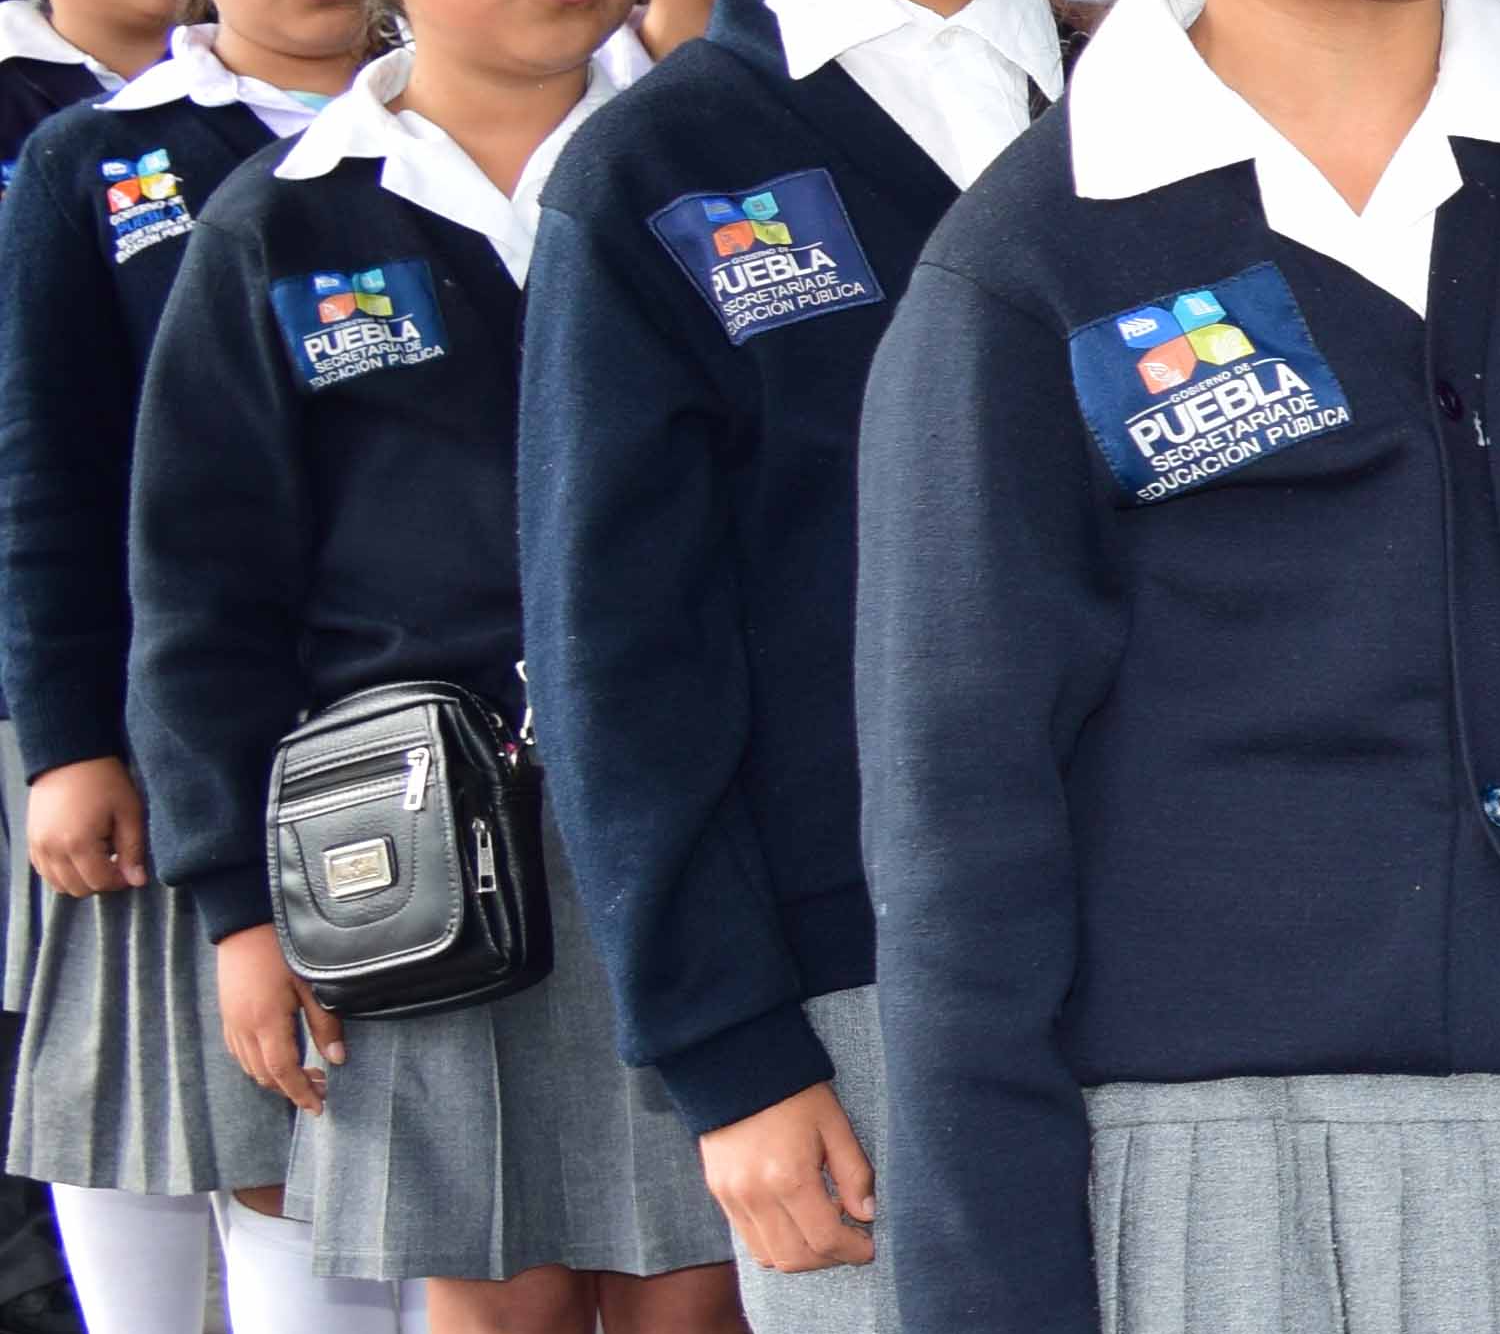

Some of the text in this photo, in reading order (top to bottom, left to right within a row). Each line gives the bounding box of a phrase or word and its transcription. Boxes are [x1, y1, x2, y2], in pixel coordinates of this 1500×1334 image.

[711, 248, 837, 302] PUEBLA
[722, 271, 840, 317] SECRETARÍA DE
[797, 282, 866, 310] PÚBLICA
[303, 319, 420, 363] PUEBLA
[403, 338, 423, 353] DE
[1169, 362, 1255, 404] GOBIERNO DE
[1128, 363, 1310, 457] PUEBLA
[1151, 393, 1319, 473] SECRETARÍA DE
[1136, 406, 1350, 501] EDUCACIÓN PÚBLICA
